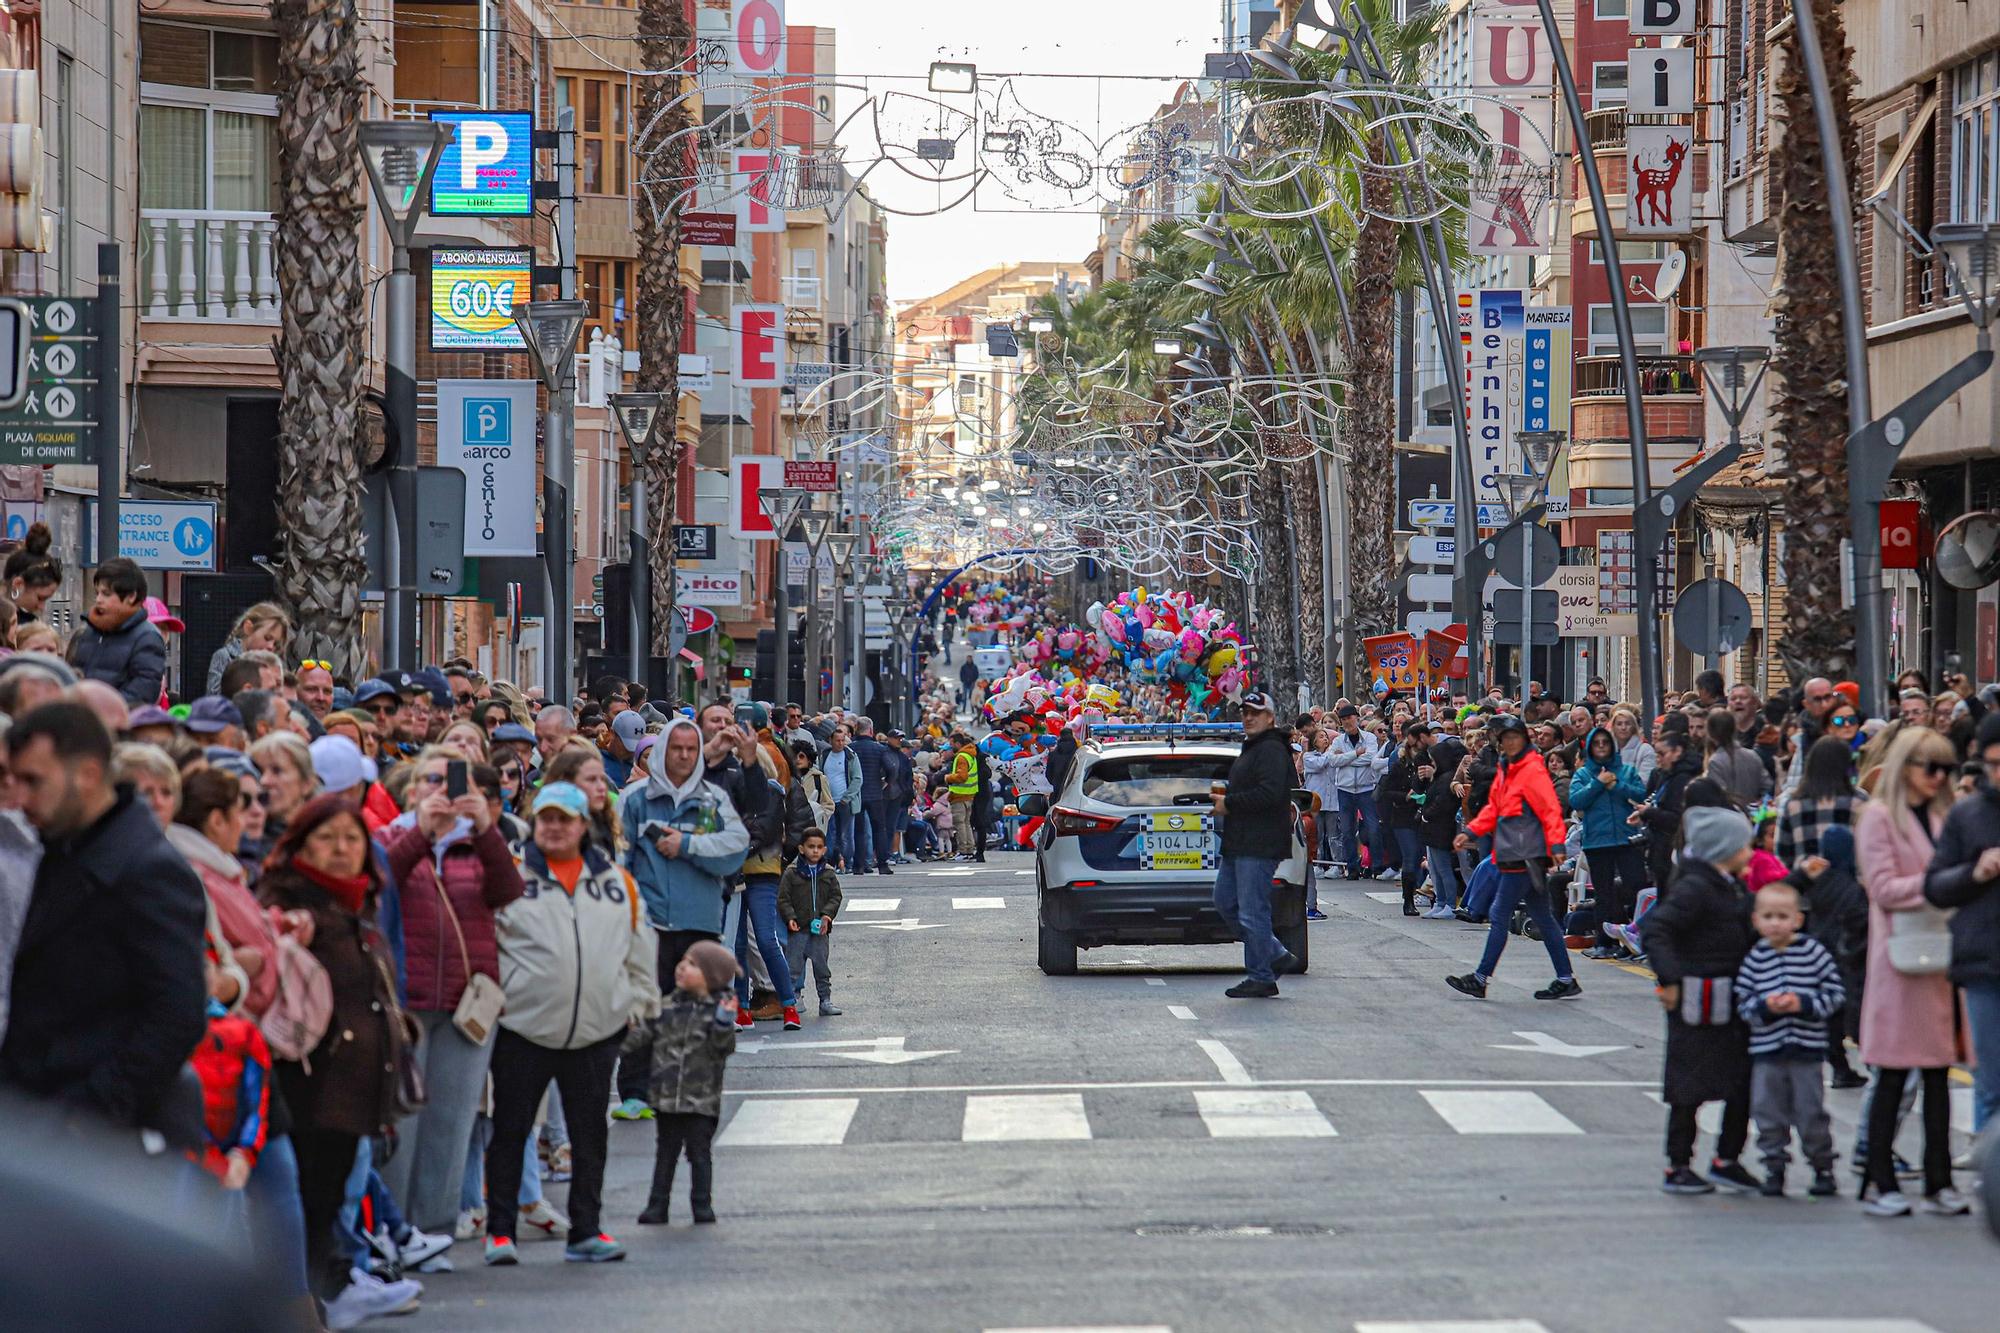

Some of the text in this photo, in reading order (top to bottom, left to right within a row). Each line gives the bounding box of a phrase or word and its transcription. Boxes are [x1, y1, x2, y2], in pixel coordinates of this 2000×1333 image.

[461, 121, 508, 188] P
[467, 199, 495, 207] LIBRE
[440, 253, 522, 264] ABONO MENSUAL
[449, 279, 515, 318] 60€
[1526, 312, 1571, 324] MANRESA
[5, 432, 34, 443] PLAZA
[21, 446, 76, 457] DE ORIENTE
[482, 462, 496, 541] centro
[1545, 502, 1568, 513] RESA
[119, 548, 159, 557] ARKING
[1438, 543, 1455, 551] ESP
[692, 575, 738, 590] rico
[1559, 572, 1596, 587] dorsia
[1560, 595, 1593, 608] eva
[1573, 614, 1609, 628] origen
[1379, 656, 1409, 668] SOS
[1147, 836, 1211, 849] 5104 LJP
